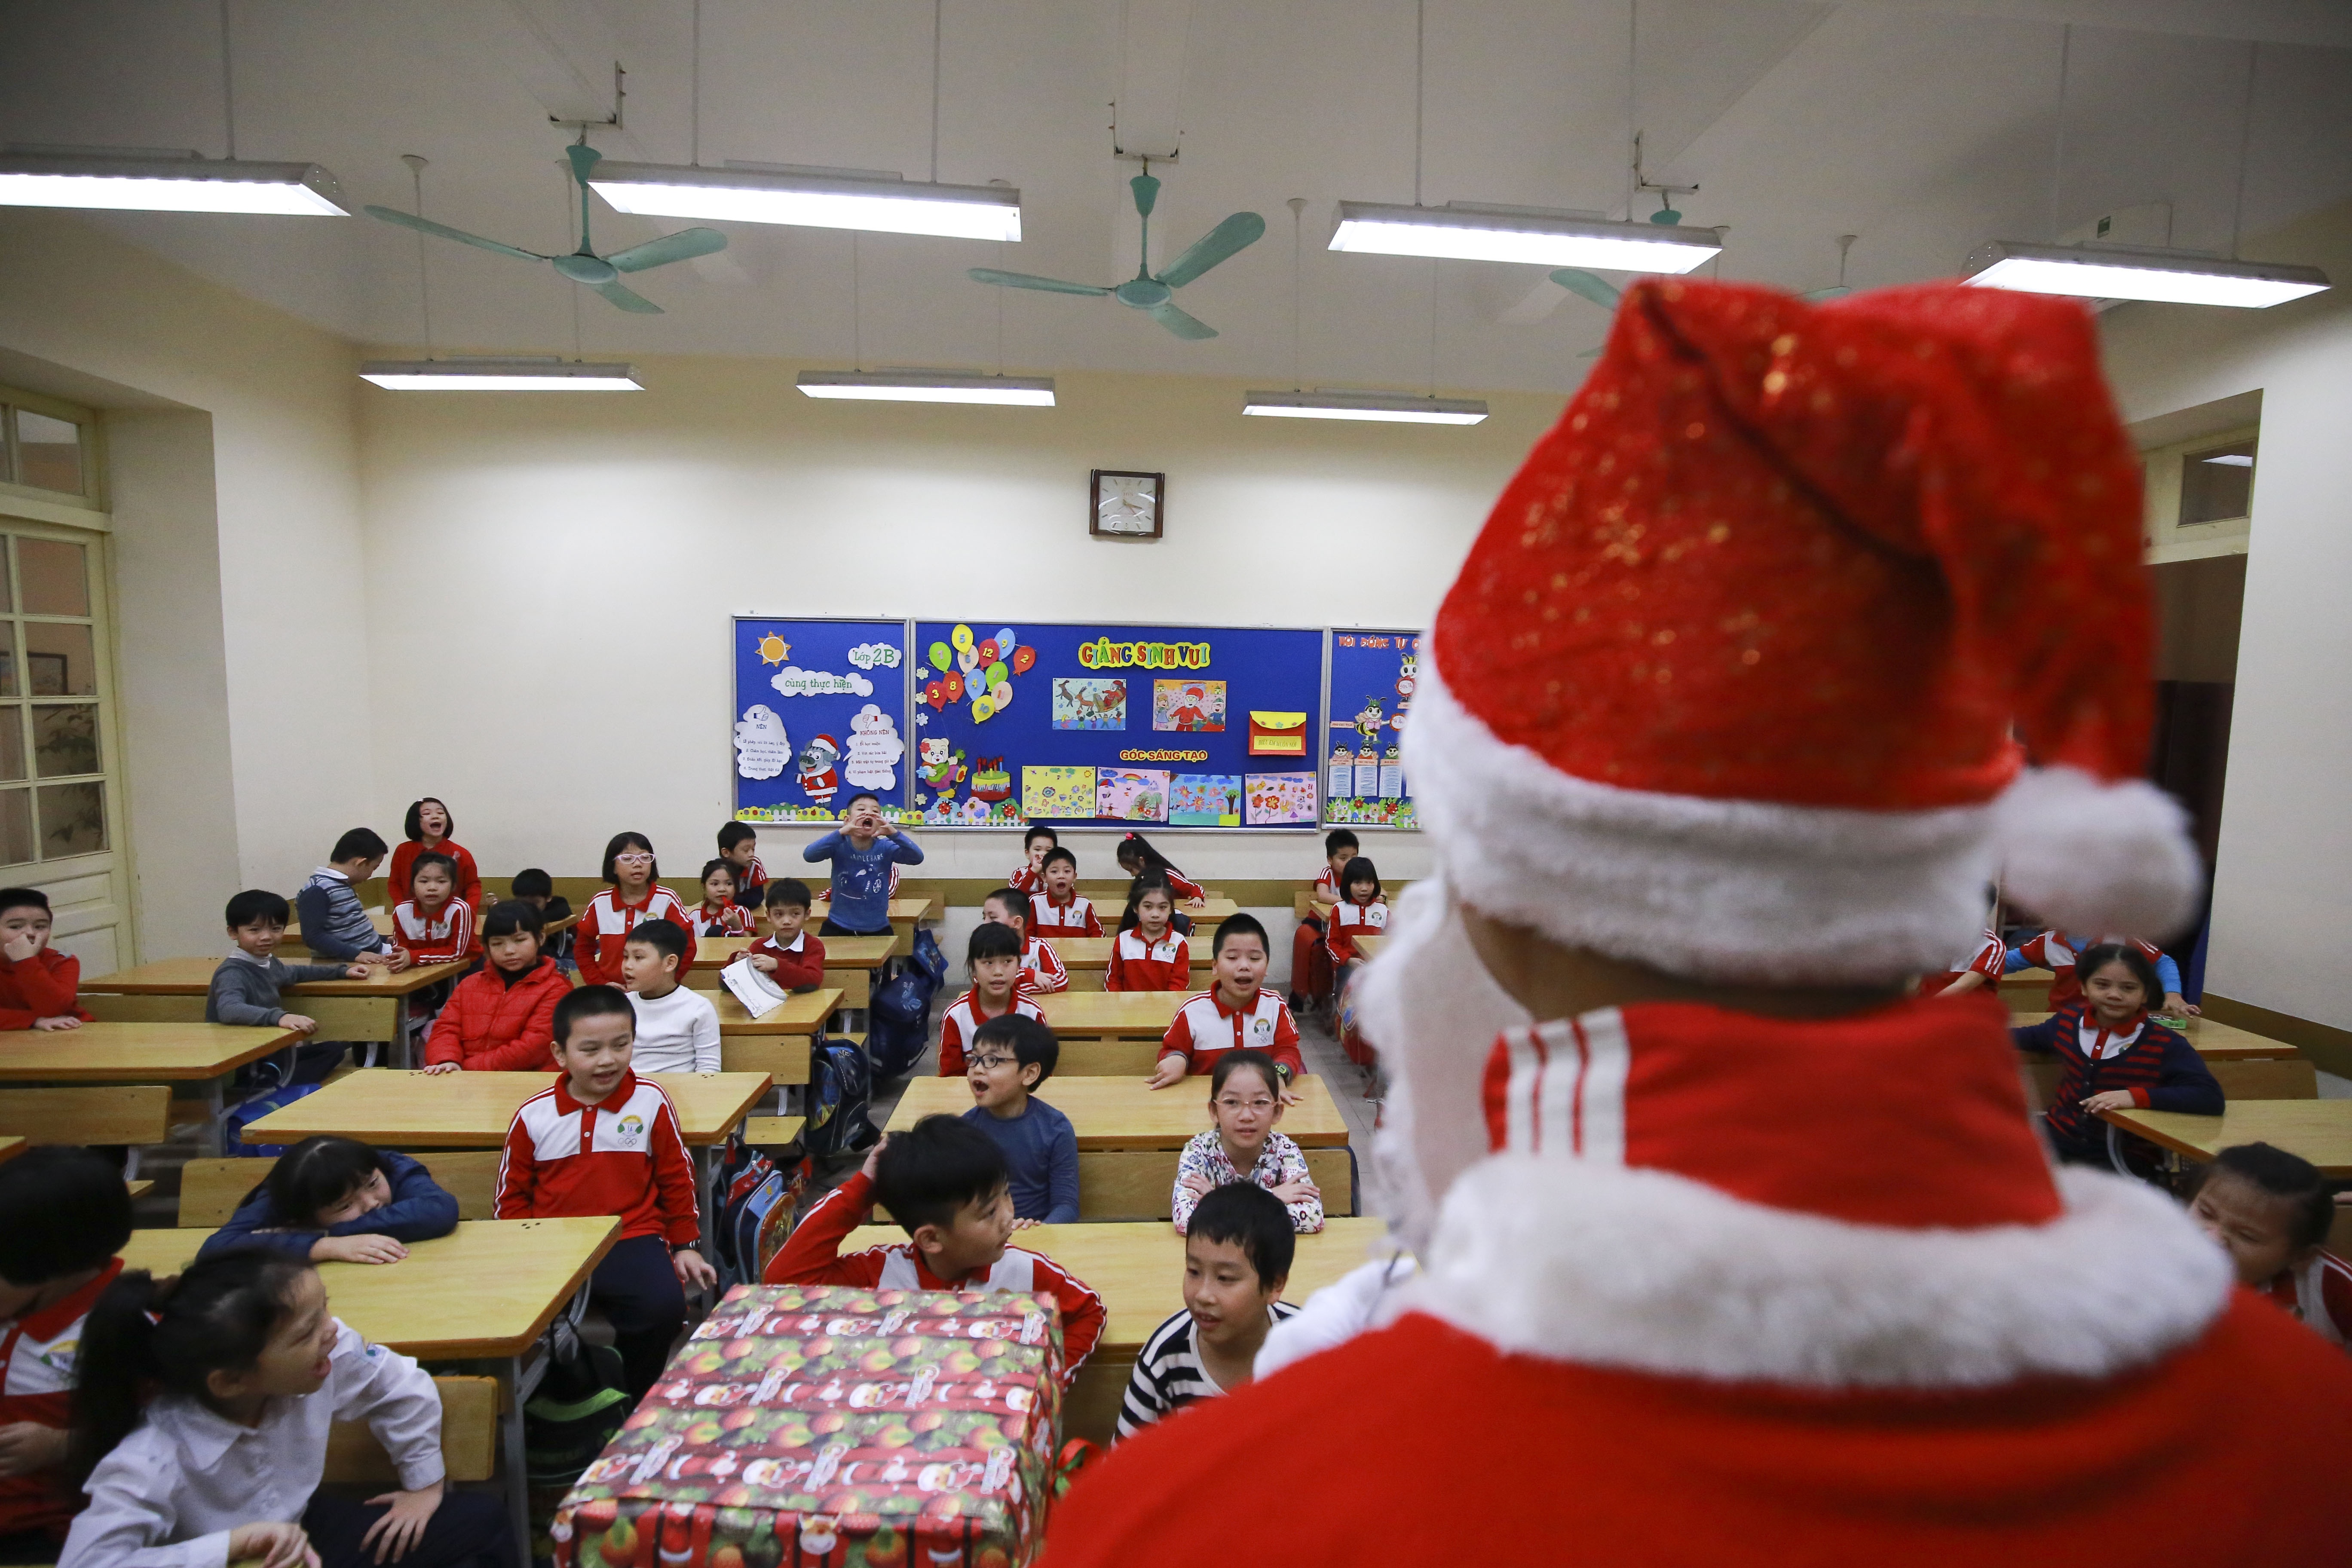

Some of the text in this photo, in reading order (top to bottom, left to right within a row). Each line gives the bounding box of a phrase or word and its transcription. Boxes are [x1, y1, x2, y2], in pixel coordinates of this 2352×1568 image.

[959, 634, 965, 643] 5
[1001, 639, 1008, 648] 9
[854, 648, 894, 664] Lớp 2B
[983, 647, 993, 658] 12
[1082, 640, 1206, 665] GIÁNG SINH VUI
[1020, 654, 1029, 664] 2
[785, 678, 806, 690] cùng
[810, 679, 830, 690] thực
[949, 681, 957, 691] 8
[971, 678, 977, 688] 4
[932, 689, 939, 698] 3
[979, 703, 989, 714] 10
[1121, 749, 1207, 761] GÓC SÁNG TẠO
